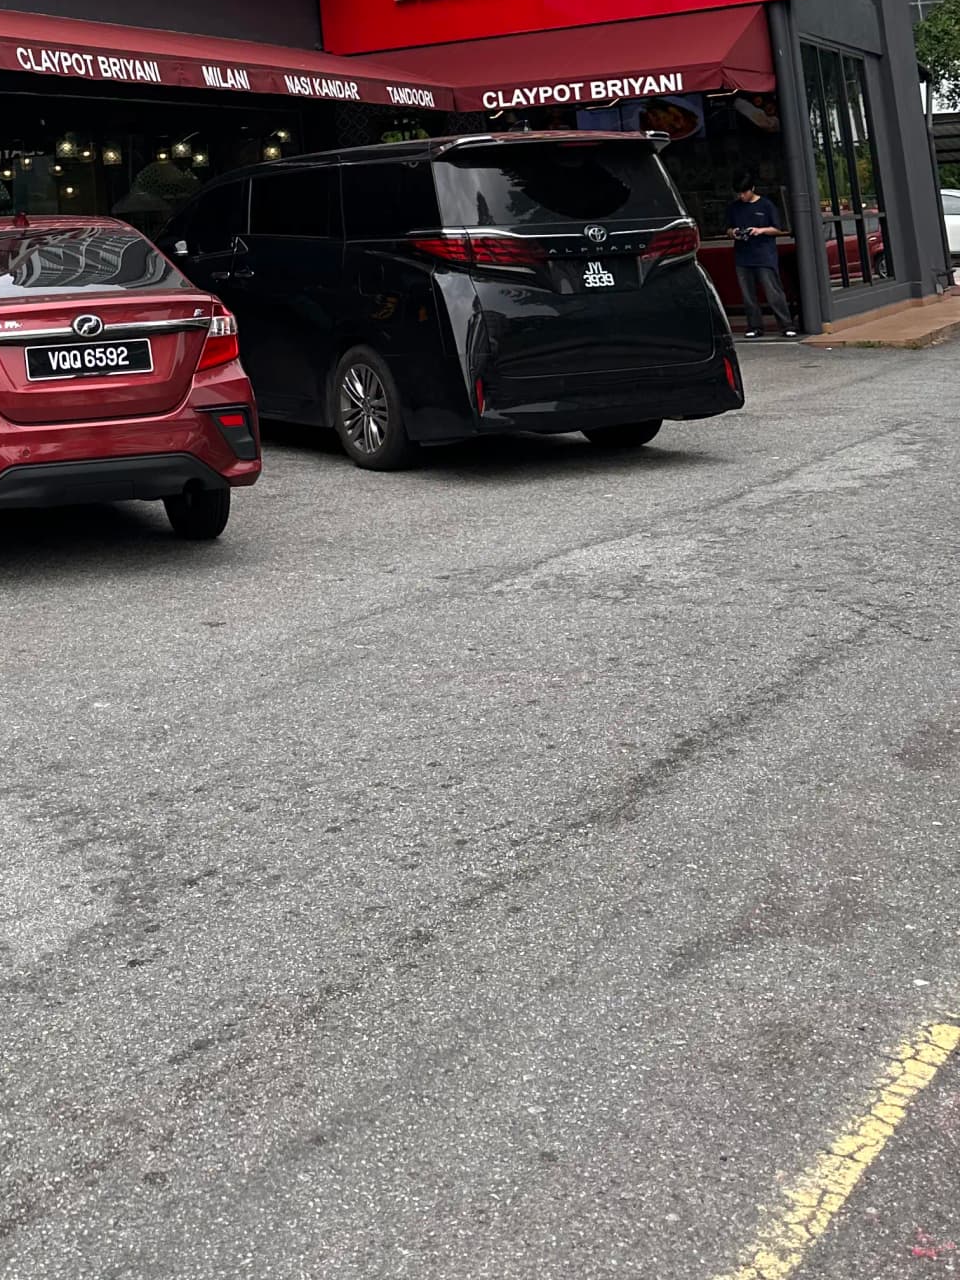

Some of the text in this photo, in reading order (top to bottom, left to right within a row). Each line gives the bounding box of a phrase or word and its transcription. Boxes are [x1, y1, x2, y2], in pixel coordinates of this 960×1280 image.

[15, 46, 161, 83] CLAYPOT BRIYANI
[201, 65, 250, 91] MILANI
[283, 74, 360, 101] NASI KANDAR
[386, 86, 434, 108] TANDOORI
[482, 72, 683, 109] CLAYPOT BRIYANI
[548, 243, 646, 254] ALPHARD
[585, 261, 608, 275] JYL
[583, 273, 615, 288] 3939
[47, 346, 130, 370] VQQ 6592
